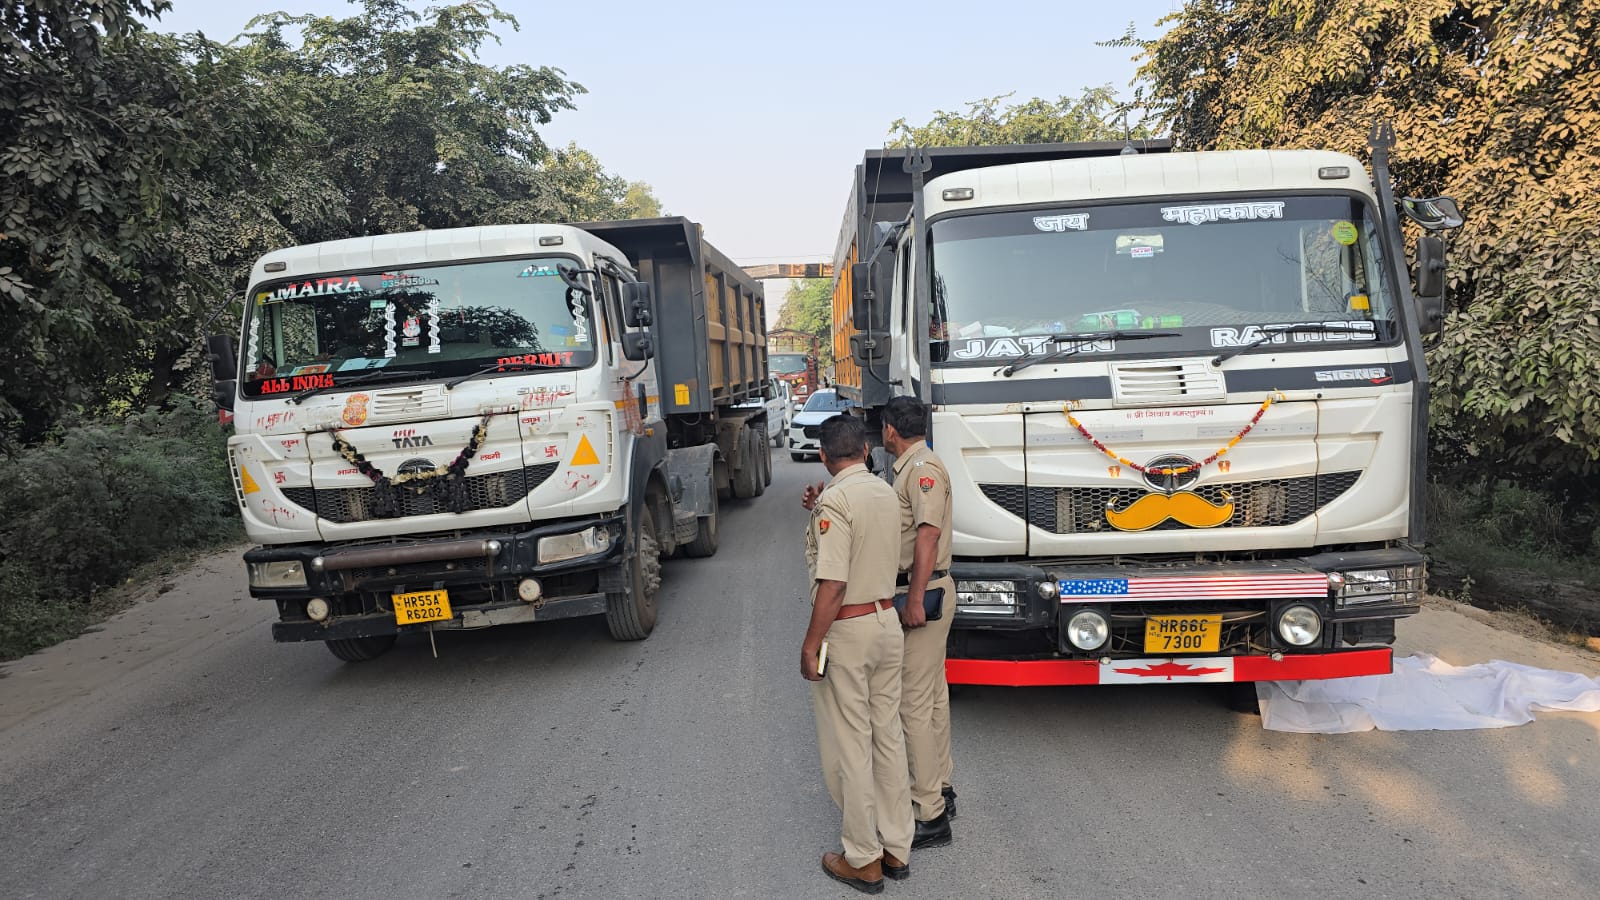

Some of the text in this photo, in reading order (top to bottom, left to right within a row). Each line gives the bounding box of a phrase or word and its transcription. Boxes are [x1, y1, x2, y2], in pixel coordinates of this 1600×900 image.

[1033, 201, 1286, 232] जय महाकाल
[953, 336, 1116, 359] JATIN
[261, 351, 574, 394] ALL INDIA PERMIT
[392, 435, 434, 449] TATA
[404, 594, 440, 608] HR55A
[406, 607, 443, 620] R6202
[1160, 618, 1209, 633] HR66C
[1163, 635, 1202, 650] 7300
